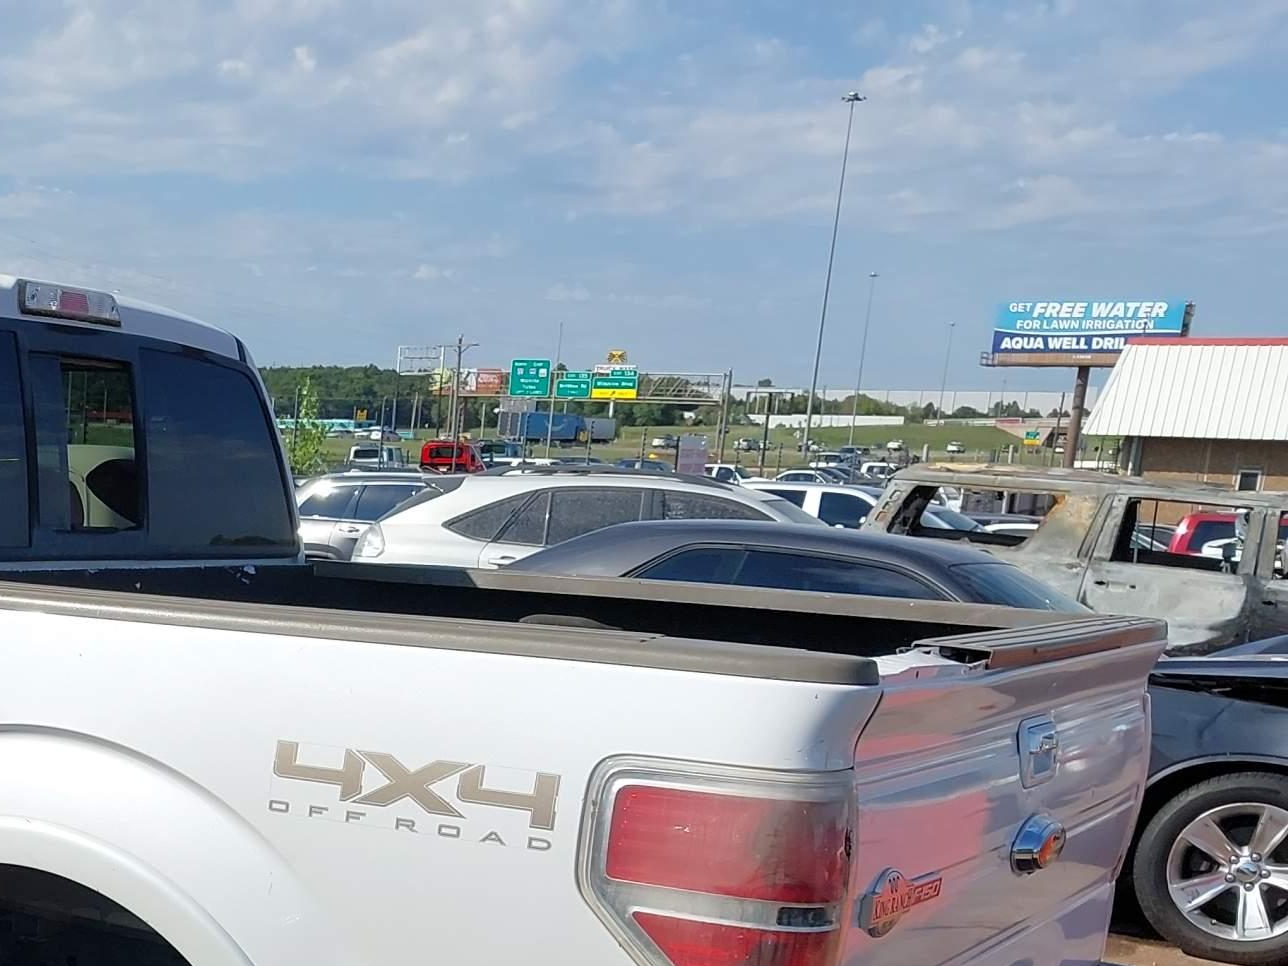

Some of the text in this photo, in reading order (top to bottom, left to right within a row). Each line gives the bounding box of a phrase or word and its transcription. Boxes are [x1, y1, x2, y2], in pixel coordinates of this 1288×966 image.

[1009, 302, 1168, 318] GET FREE WATER
[1016, 319, 1154, 330] FOR LAWN IRRIGATION
[1000, 337, 1044, 349] AQUA
[1047, 337, 1088, 349] WELL
